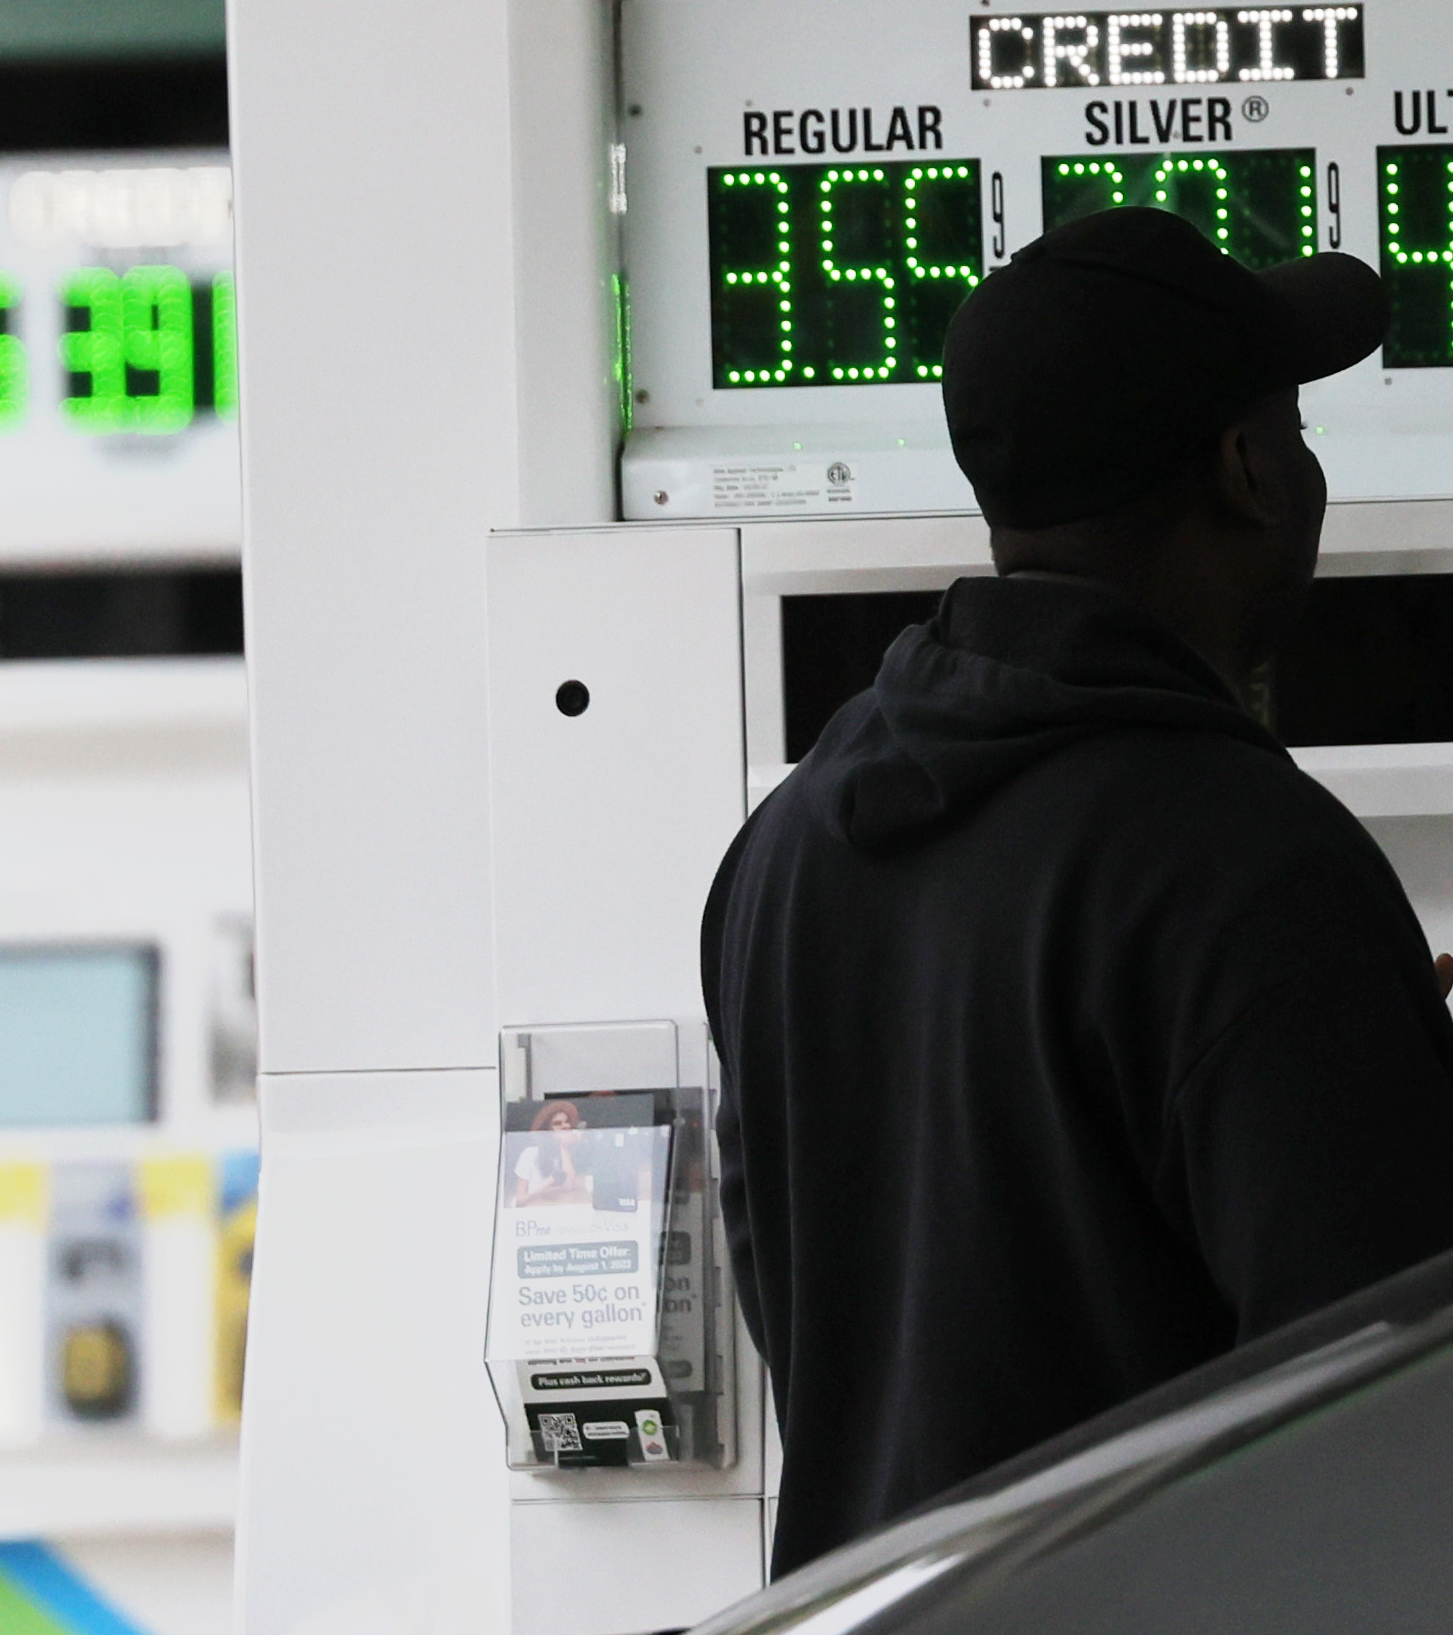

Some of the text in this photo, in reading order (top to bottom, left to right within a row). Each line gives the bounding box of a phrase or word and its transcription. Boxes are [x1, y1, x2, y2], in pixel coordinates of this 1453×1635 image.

[977, 5, 1359, 87] CREDIT
[742, 104, 943, 156] REGULAR
[523, 1249, 567, 1263] Limited
[569, 1247, 597, 1260] Time
[517, 1285, 568, 1305] Save
[571, 1284, 608, 1305] 50¢
[613, 1285, 640, 1301] on
[519, 1309, 575, 1329] every
